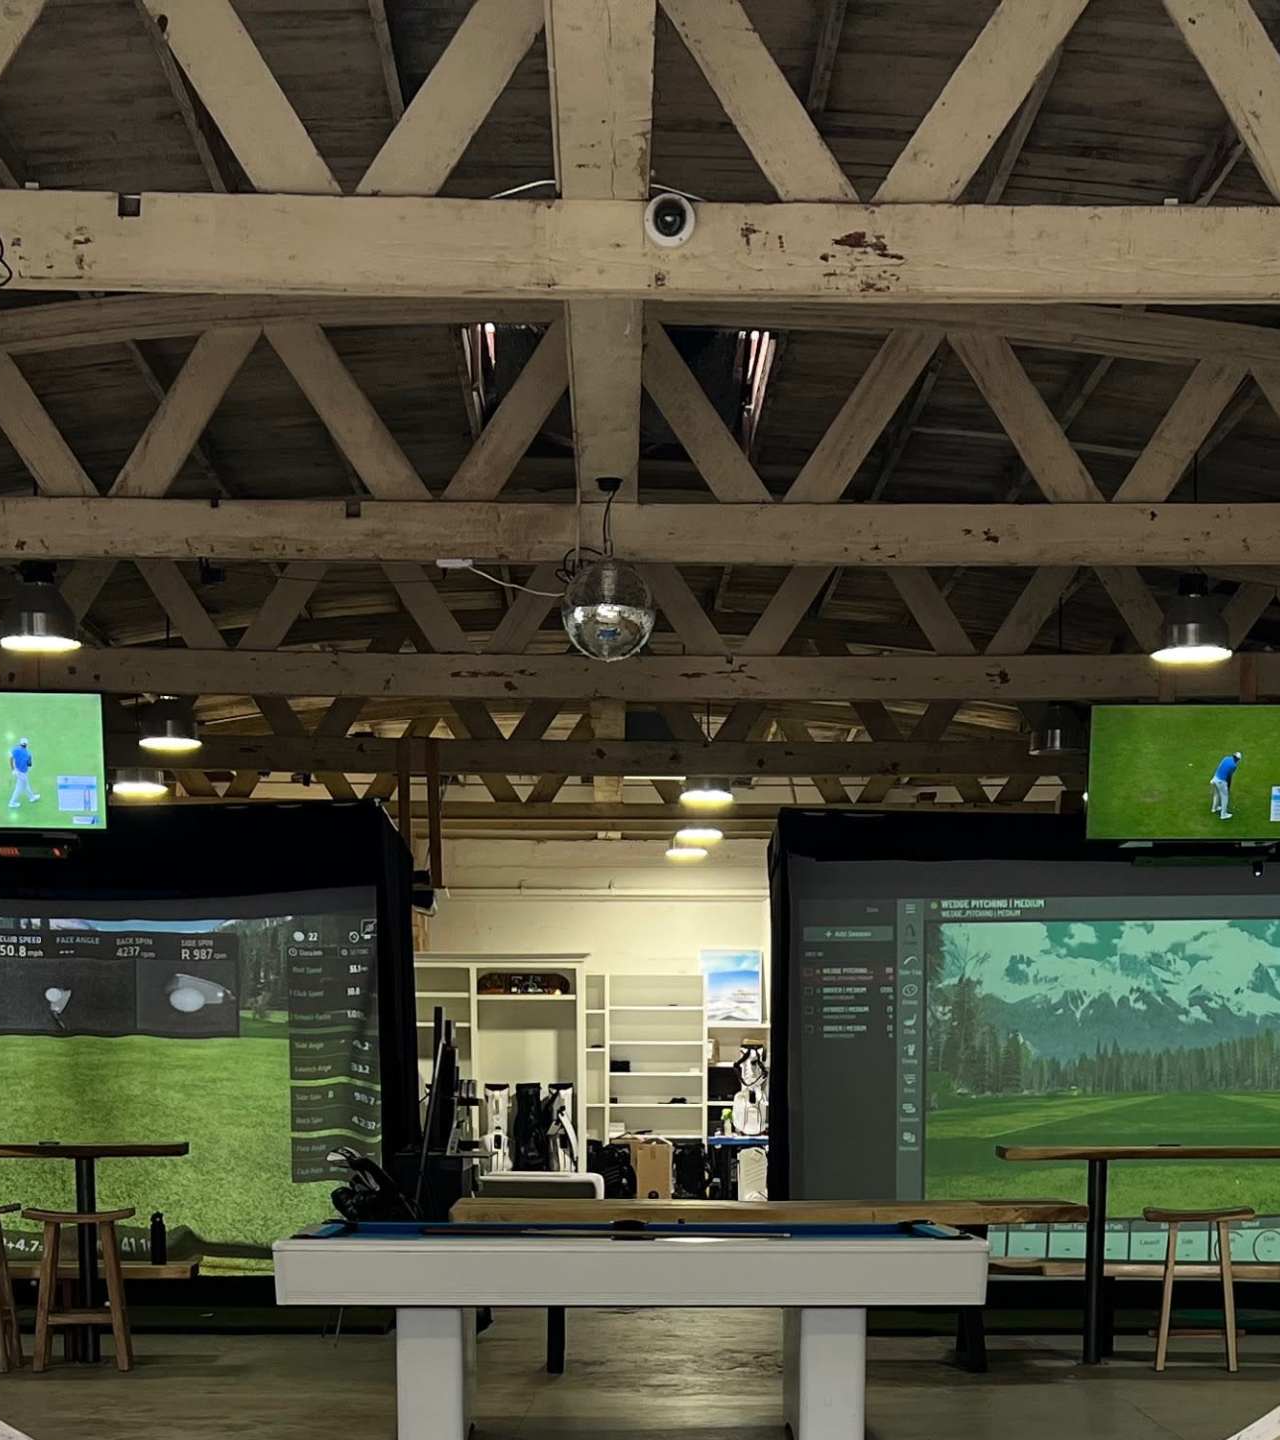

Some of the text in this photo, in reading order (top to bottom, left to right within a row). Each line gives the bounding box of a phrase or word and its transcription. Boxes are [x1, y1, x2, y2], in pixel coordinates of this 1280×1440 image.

[942, 900, 969, 909] WEDGE
[971, 899, 1008, 908] PITCHING
[1014, 899, 1044, 908] MEDIUM
[0, 936, 41, 944] CLUB SPEED
[307, 932, 318, 941] 22
[0, 945, 26, 957] 50.8
[116, 948, 140, 957] 4237
[181, 948, 190, 960] R
[192, 949, 213, 960] 987
